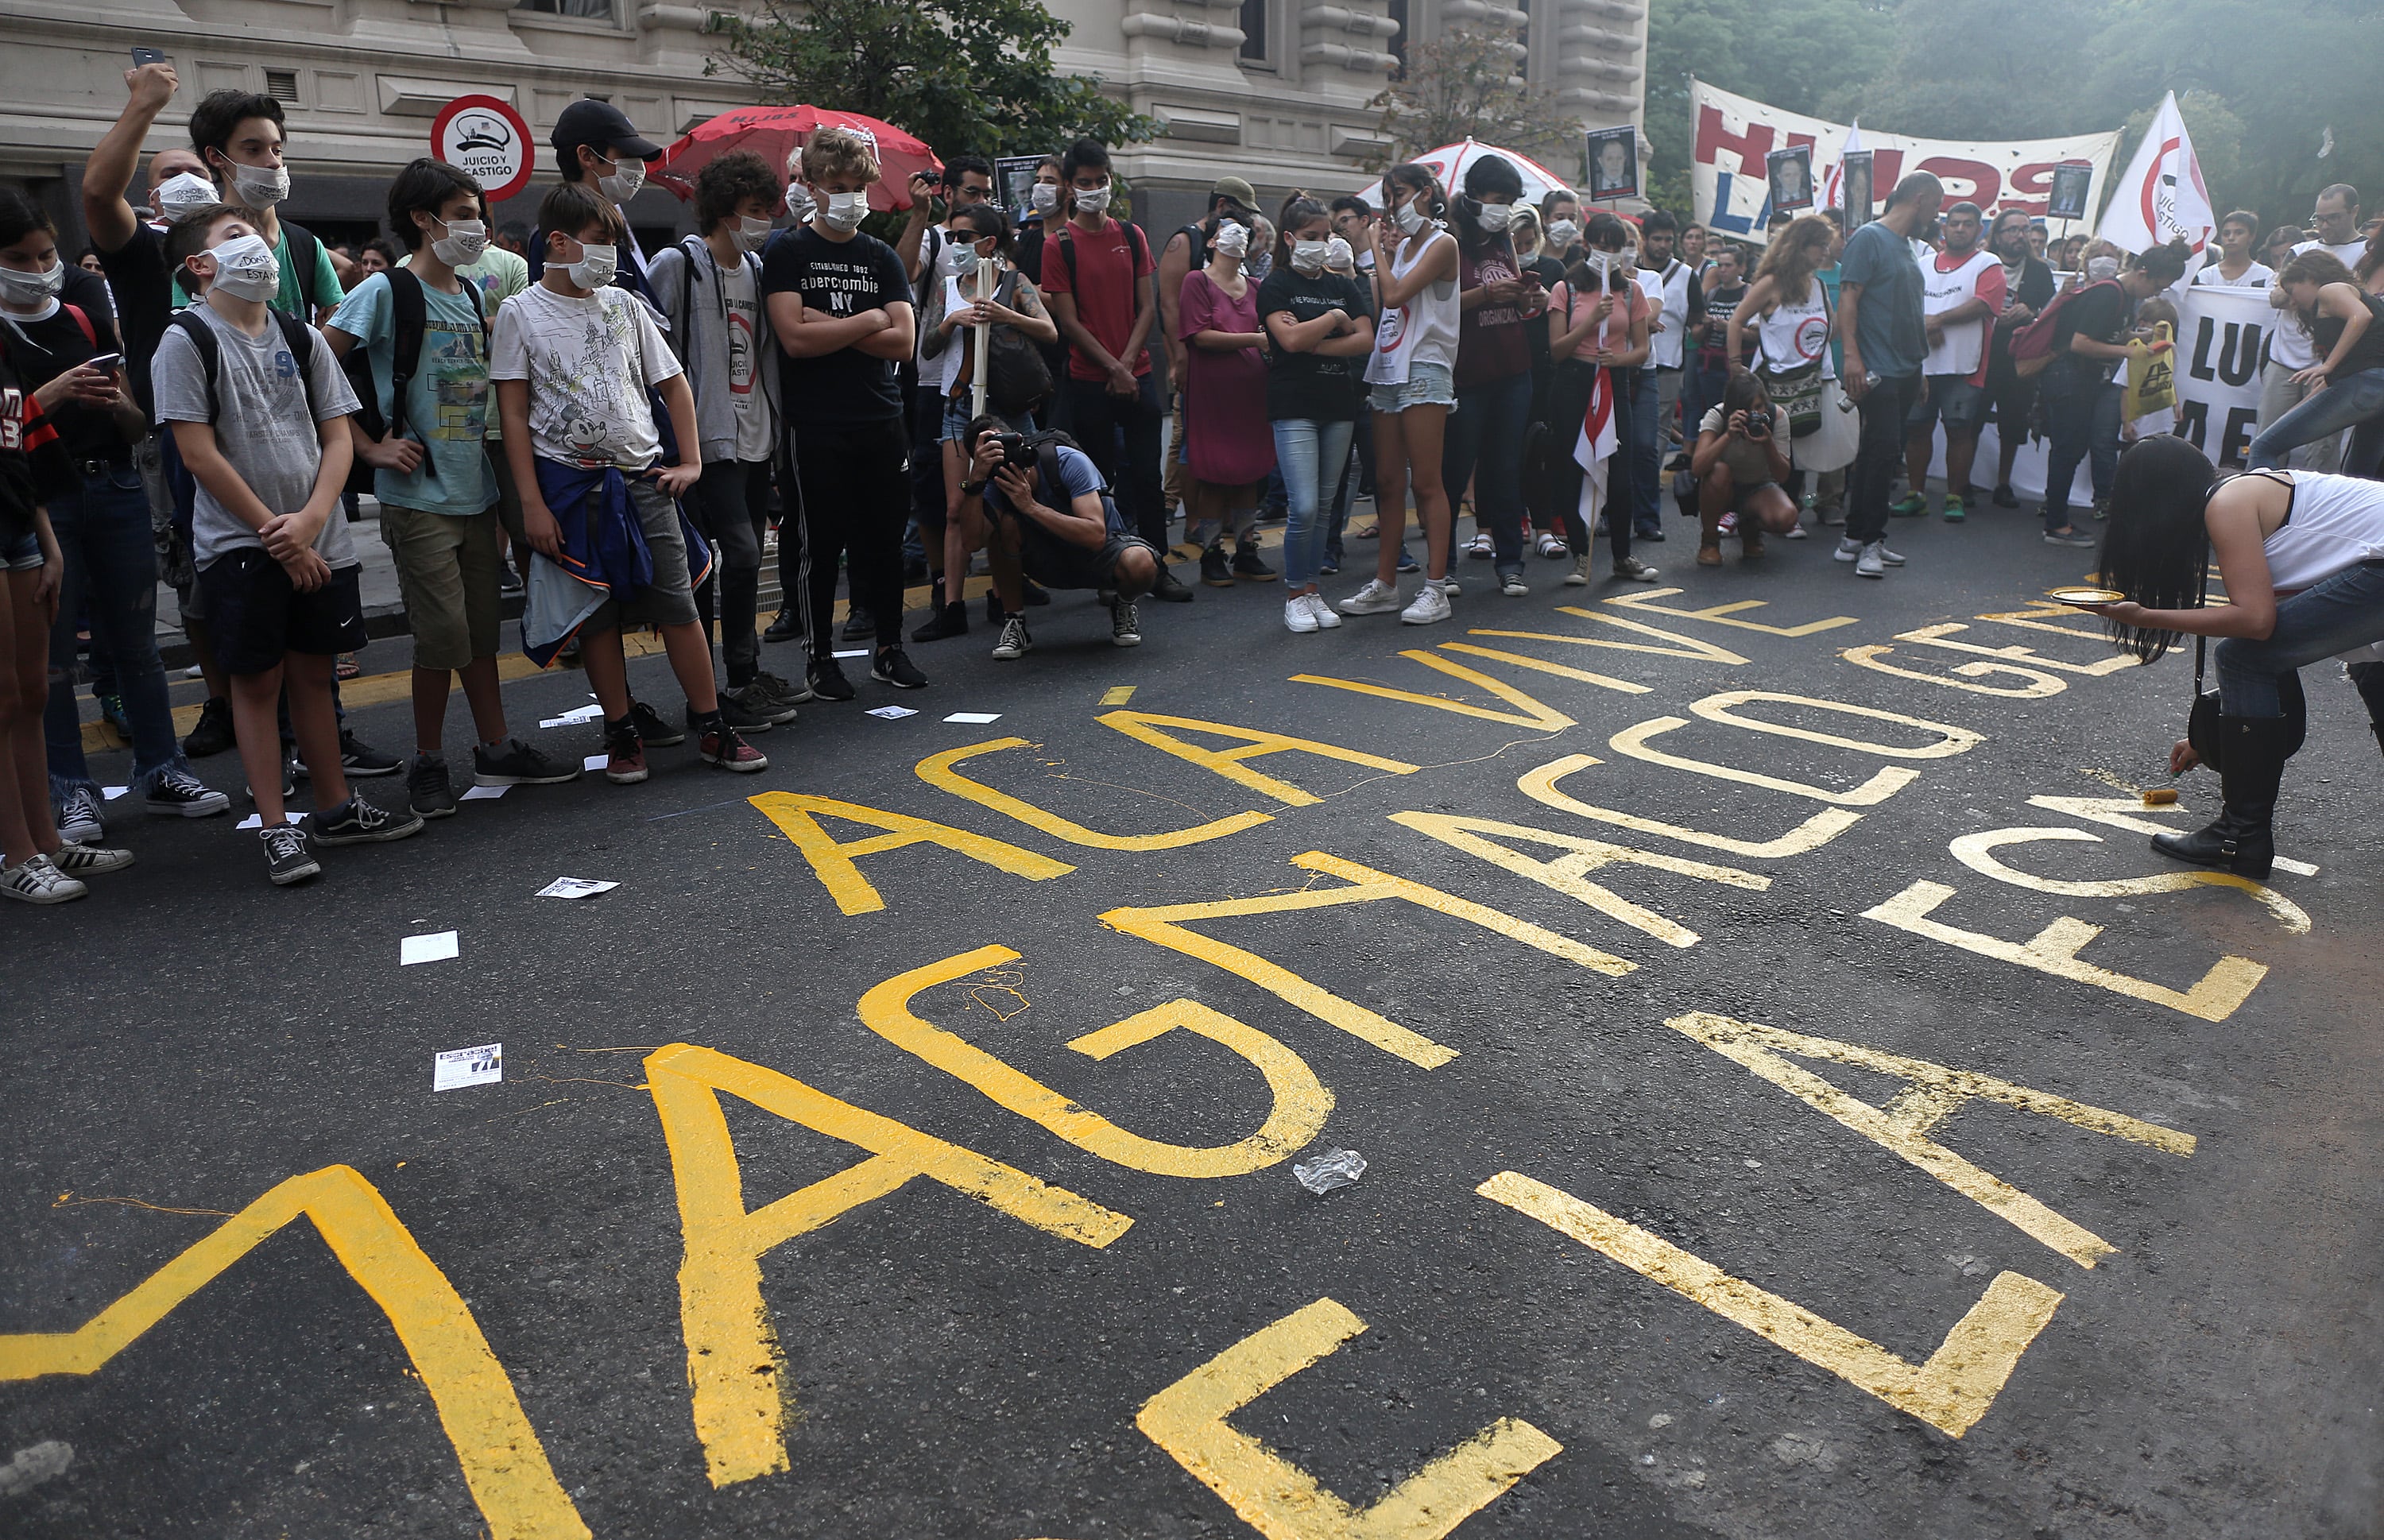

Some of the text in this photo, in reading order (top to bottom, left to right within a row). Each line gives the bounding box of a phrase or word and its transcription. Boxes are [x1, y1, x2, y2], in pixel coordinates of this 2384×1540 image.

[462, 155, 508, 166] JUICIO Y
[464, 165, 513, 177] CASTIGO
[829, 291, 853, 312] NY
[275, 350, 300, 378] 9
[2189, 316, 2275, 387] LU
[747, 586, 1860, 915] ACÁ VIVE
[1476, 1009, 2198, 1437] LA
